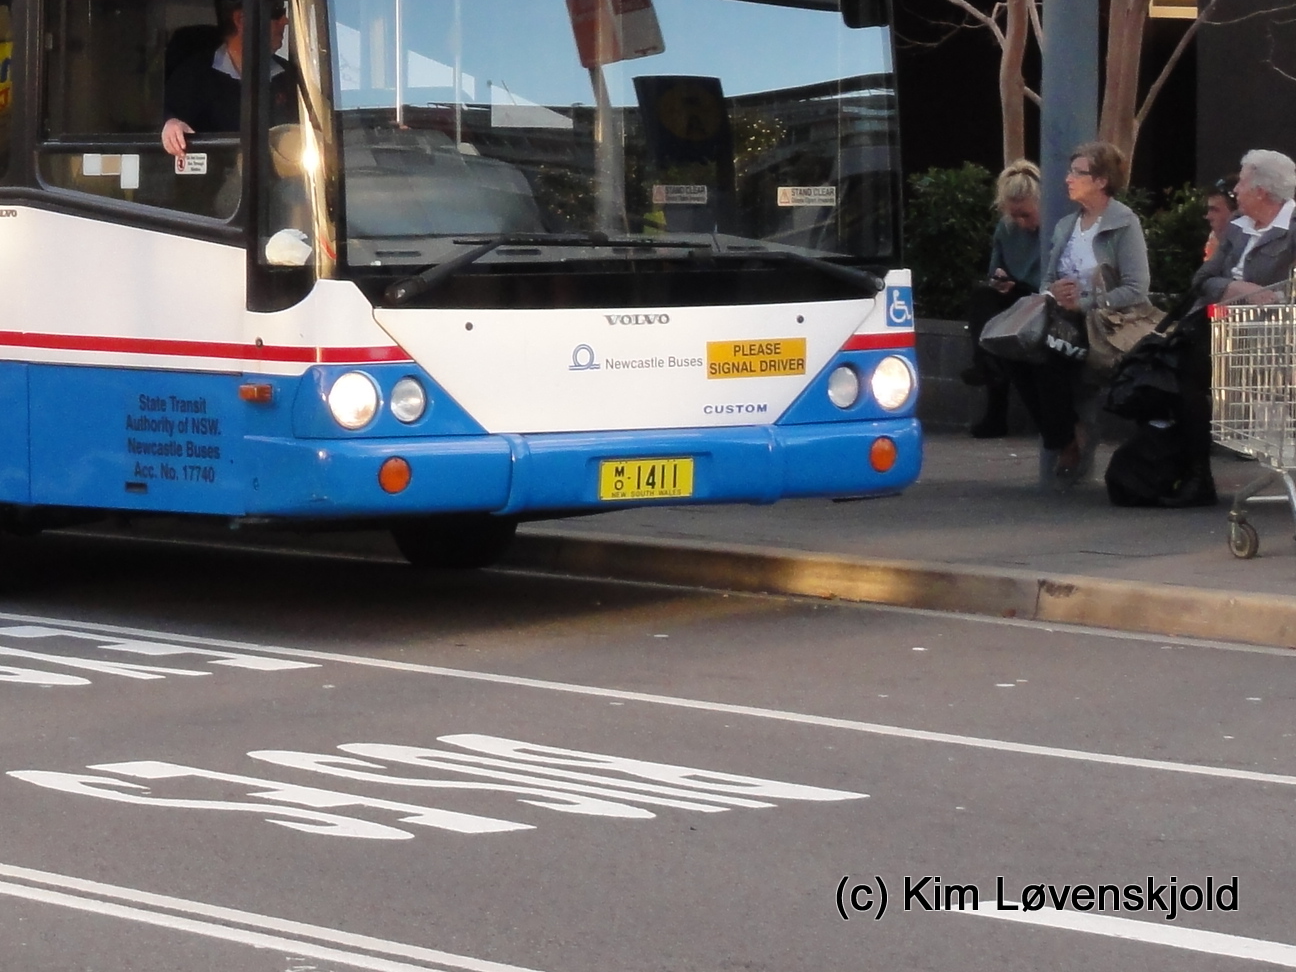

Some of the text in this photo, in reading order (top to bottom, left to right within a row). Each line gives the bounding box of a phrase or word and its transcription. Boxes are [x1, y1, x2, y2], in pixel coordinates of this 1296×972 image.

[791, 188, 834, 197] STAND CLEAR
[604, 313, 671, 326] VOLVO
[733, 343, 782, 357] PLEASE
[605, 356, 704, 371] Newcastle Buses
[709, 358, 805, 376] SIGNAL DRIVER
[138, 393, 207, 414] State Transit
[703, 403, 768, 415] CUSTOM
[126, 414, 175, 437] Authority
[177, 417, 189, 434] of
[127, 438, 221, 460] Newcastle Buses
[182, 464, 215, 483] 17740
[636, 464, 678, 490] 1411
[630, 490, 655, 498] SOUTH
[6, 733, 871, 840] BUSES
